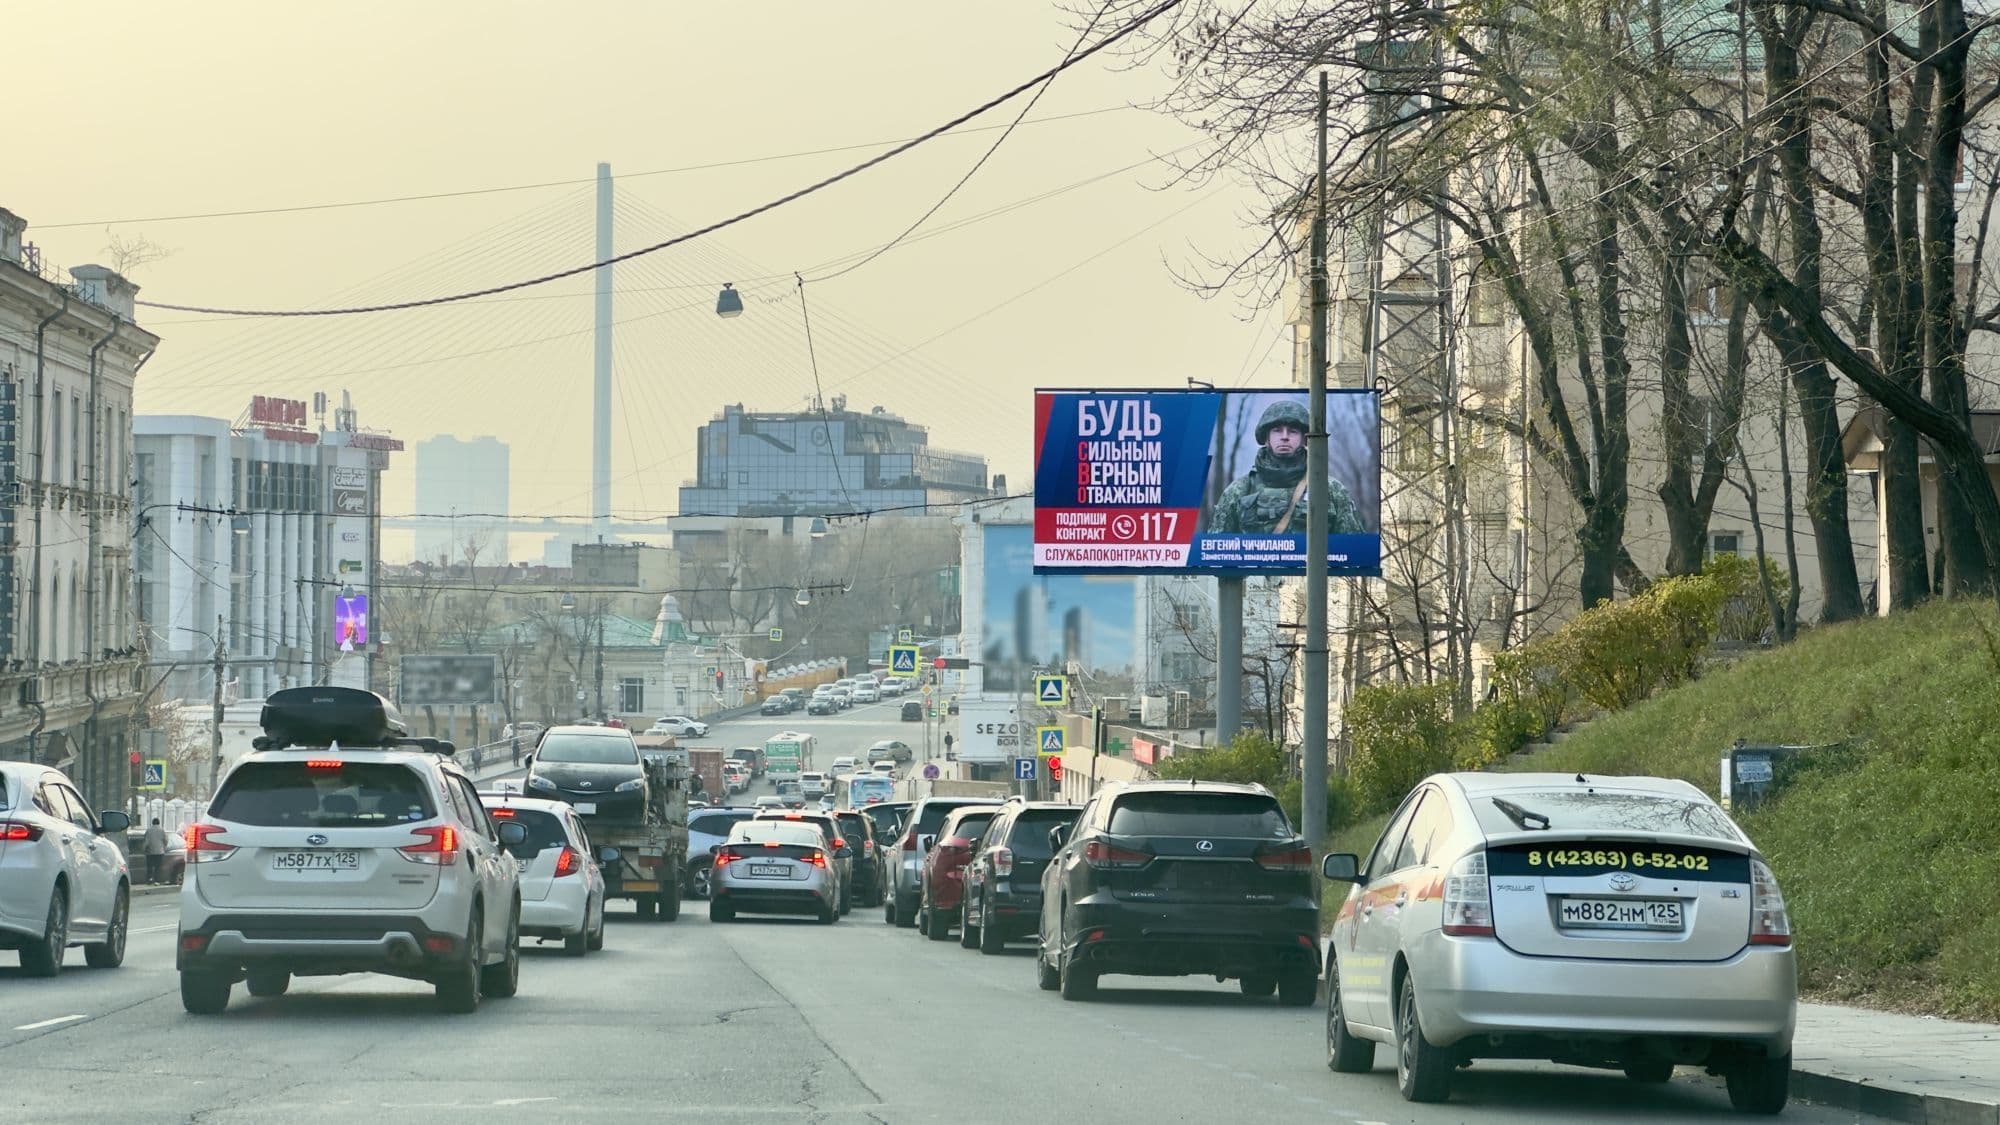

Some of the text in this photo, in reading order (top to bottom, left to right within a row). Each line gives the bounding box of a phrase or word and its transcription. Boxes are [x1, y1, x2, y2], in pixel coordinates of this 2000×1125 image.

[1078, 399, 1162, 441] БУДЬ
[1077, 441, 1162, 462] СИЛЬНЫМ
[1078, 462, 1162, 486] ВЕРНЫМ
[1077, 486, 1162, 505] ОТВАЖНЫМ
[1056, 512, 1107, 527] ПОДПИШИ
[1140, 512, 1178, 541] 117
[1056, 527, 1106, 541] КОНТРАКТ
[1201, 538, 1296, 552] ЕВГЕНИЙ ЧИЧИЛАНОВ
[1045, 548, 1181, 563] СЛУЖБАПОКОНТРАКТУ.РФ
[1201, 552, 1242, 562] Заместитель
[277, 853, 356, 867] М587ТХ 125
[1528, 850, 1710, 870] 8 (42363) 6-52-02
[1567, 902, 1676, 924] М882НМ 125
